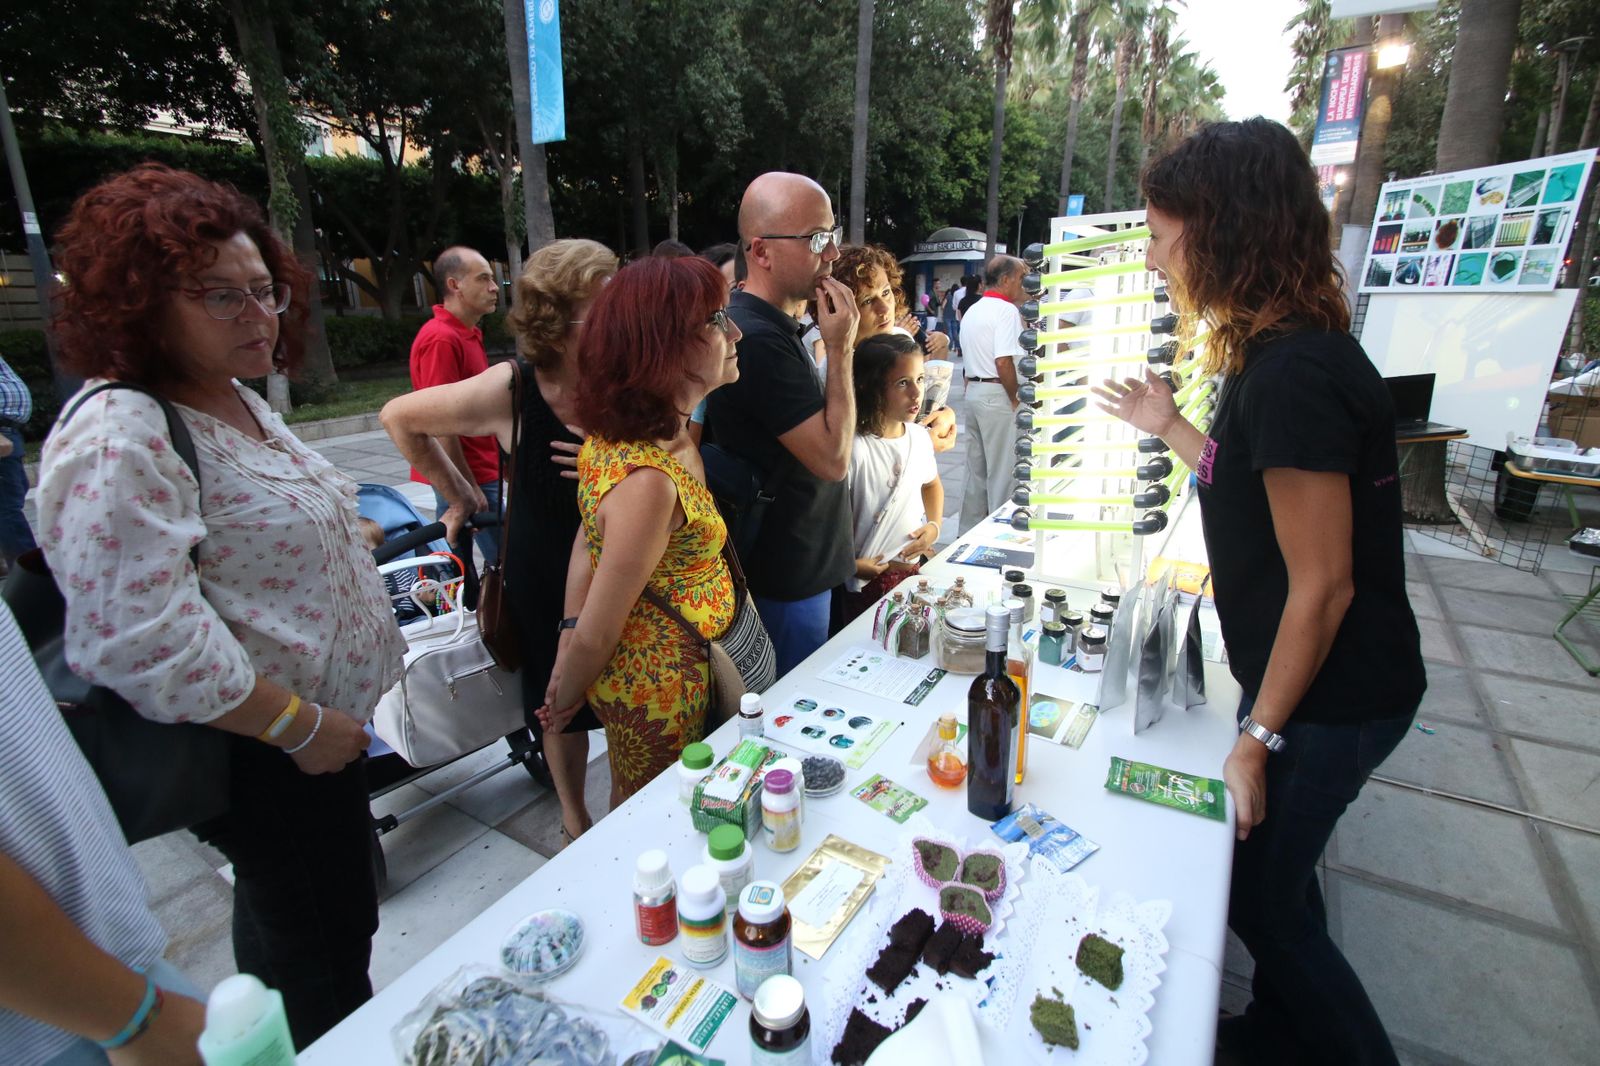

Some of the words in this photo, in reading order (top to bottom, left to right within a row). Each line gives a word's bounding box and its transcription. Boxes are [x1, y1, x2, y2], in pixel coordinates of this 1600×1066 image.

[527, 0, 535, 40] ALMERÍ
[529, 44, 536, 57] DE
[1328, 82, 1339, 108] NOCHE
[1336, 84, 1348, 120] EUROPEA
[1342, 72, 1350, 84] DE
[1326, 110, 1335, 122] LA
